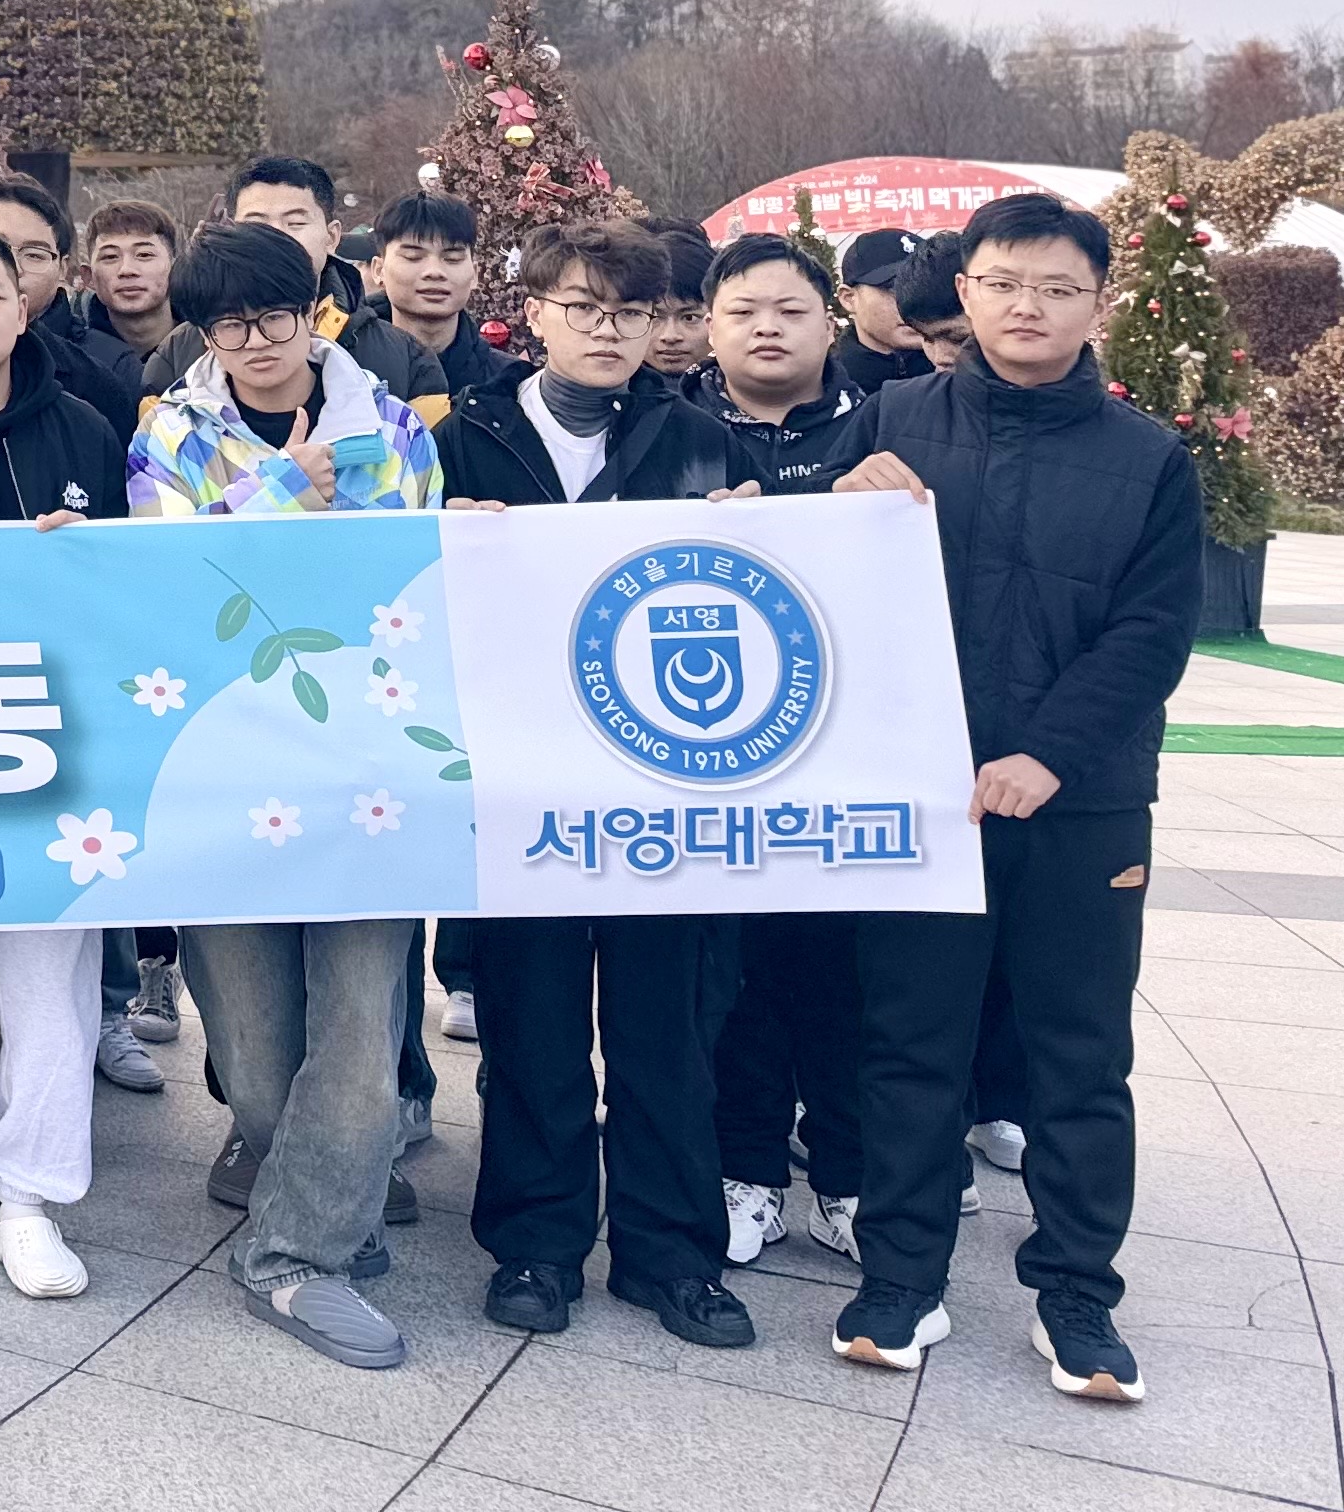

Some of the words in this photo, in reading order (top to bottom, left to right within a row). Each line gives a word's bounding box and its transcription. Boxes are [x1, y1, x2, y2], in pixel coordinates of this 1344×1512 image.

[747, 196, 783, 215] 함평
[663, 607, 721, 630] 서영
[582, 659, 671, 762] SEOYEONG
[681, 749, 739, 771] 1978
[742, 656, 813, 761] UNIVERSITY
[524, 799, 920, 874] 서영대학교
